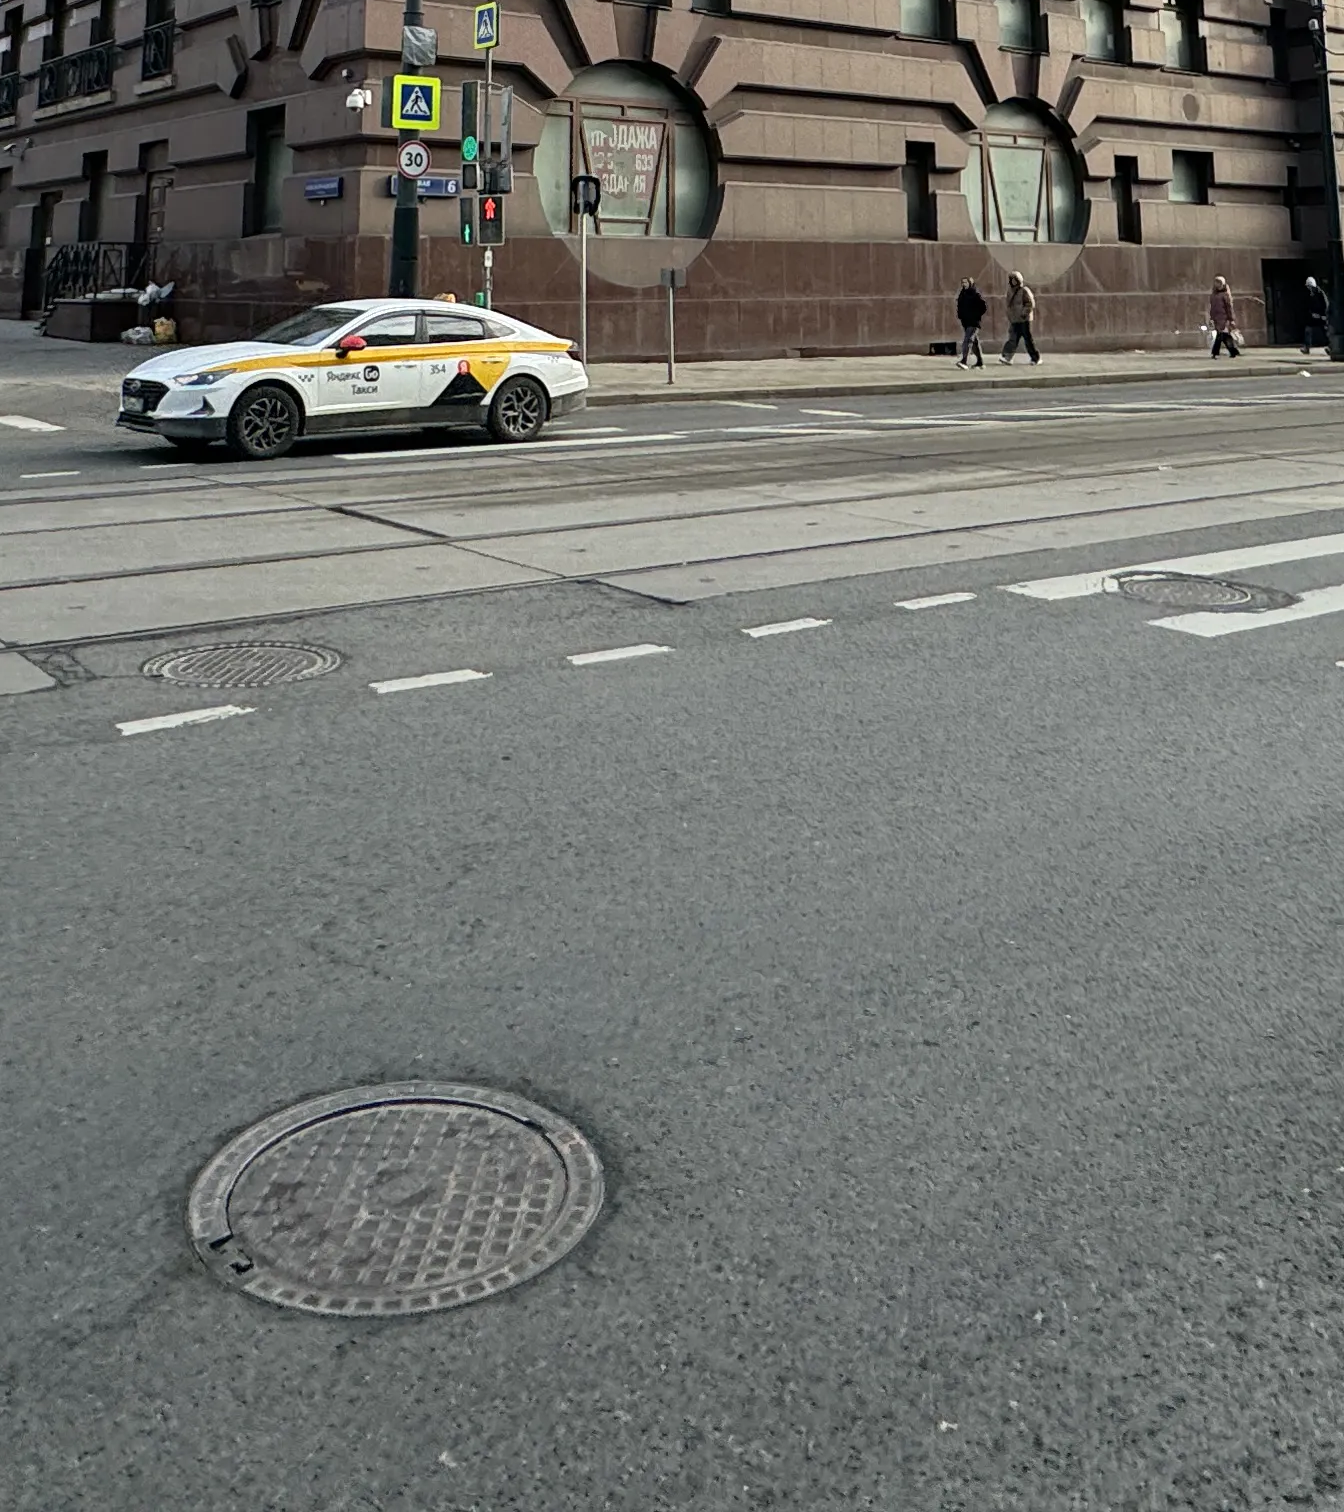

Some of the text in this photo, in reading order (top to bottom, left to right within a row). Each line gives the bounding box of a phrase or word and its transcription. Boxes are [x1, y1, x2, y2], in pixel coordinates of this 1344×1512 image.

[405, 152, 424, 168] 30
[447, 179, 457, 194] 6
[326, 366, 379, 383] Яндекс Go
[430, 364, 446, 375] 354
[351, 384, 379, 396] Такси
